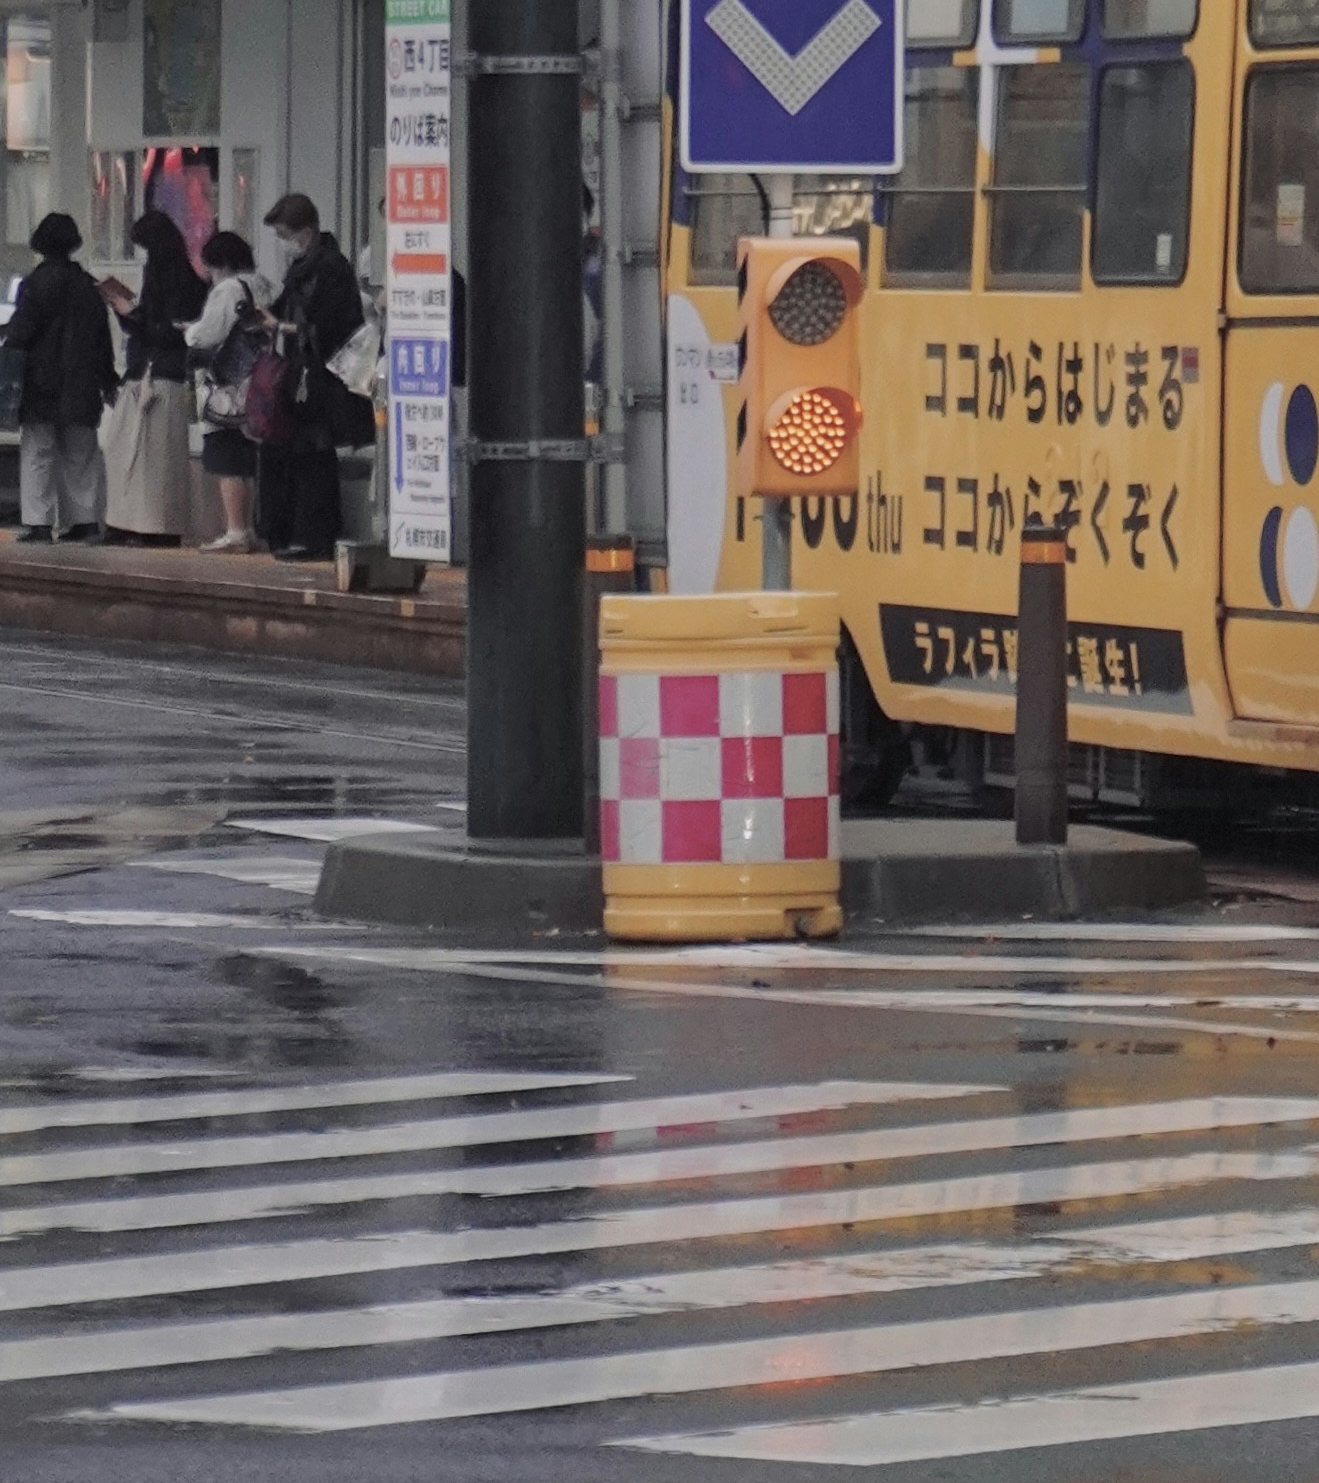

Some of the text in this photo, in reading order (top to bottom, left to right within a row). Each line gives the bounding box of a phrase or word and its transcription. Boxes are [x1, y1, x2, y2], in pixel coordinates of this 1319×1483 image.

[924, 338, 1185, 430] ココからはじまる
